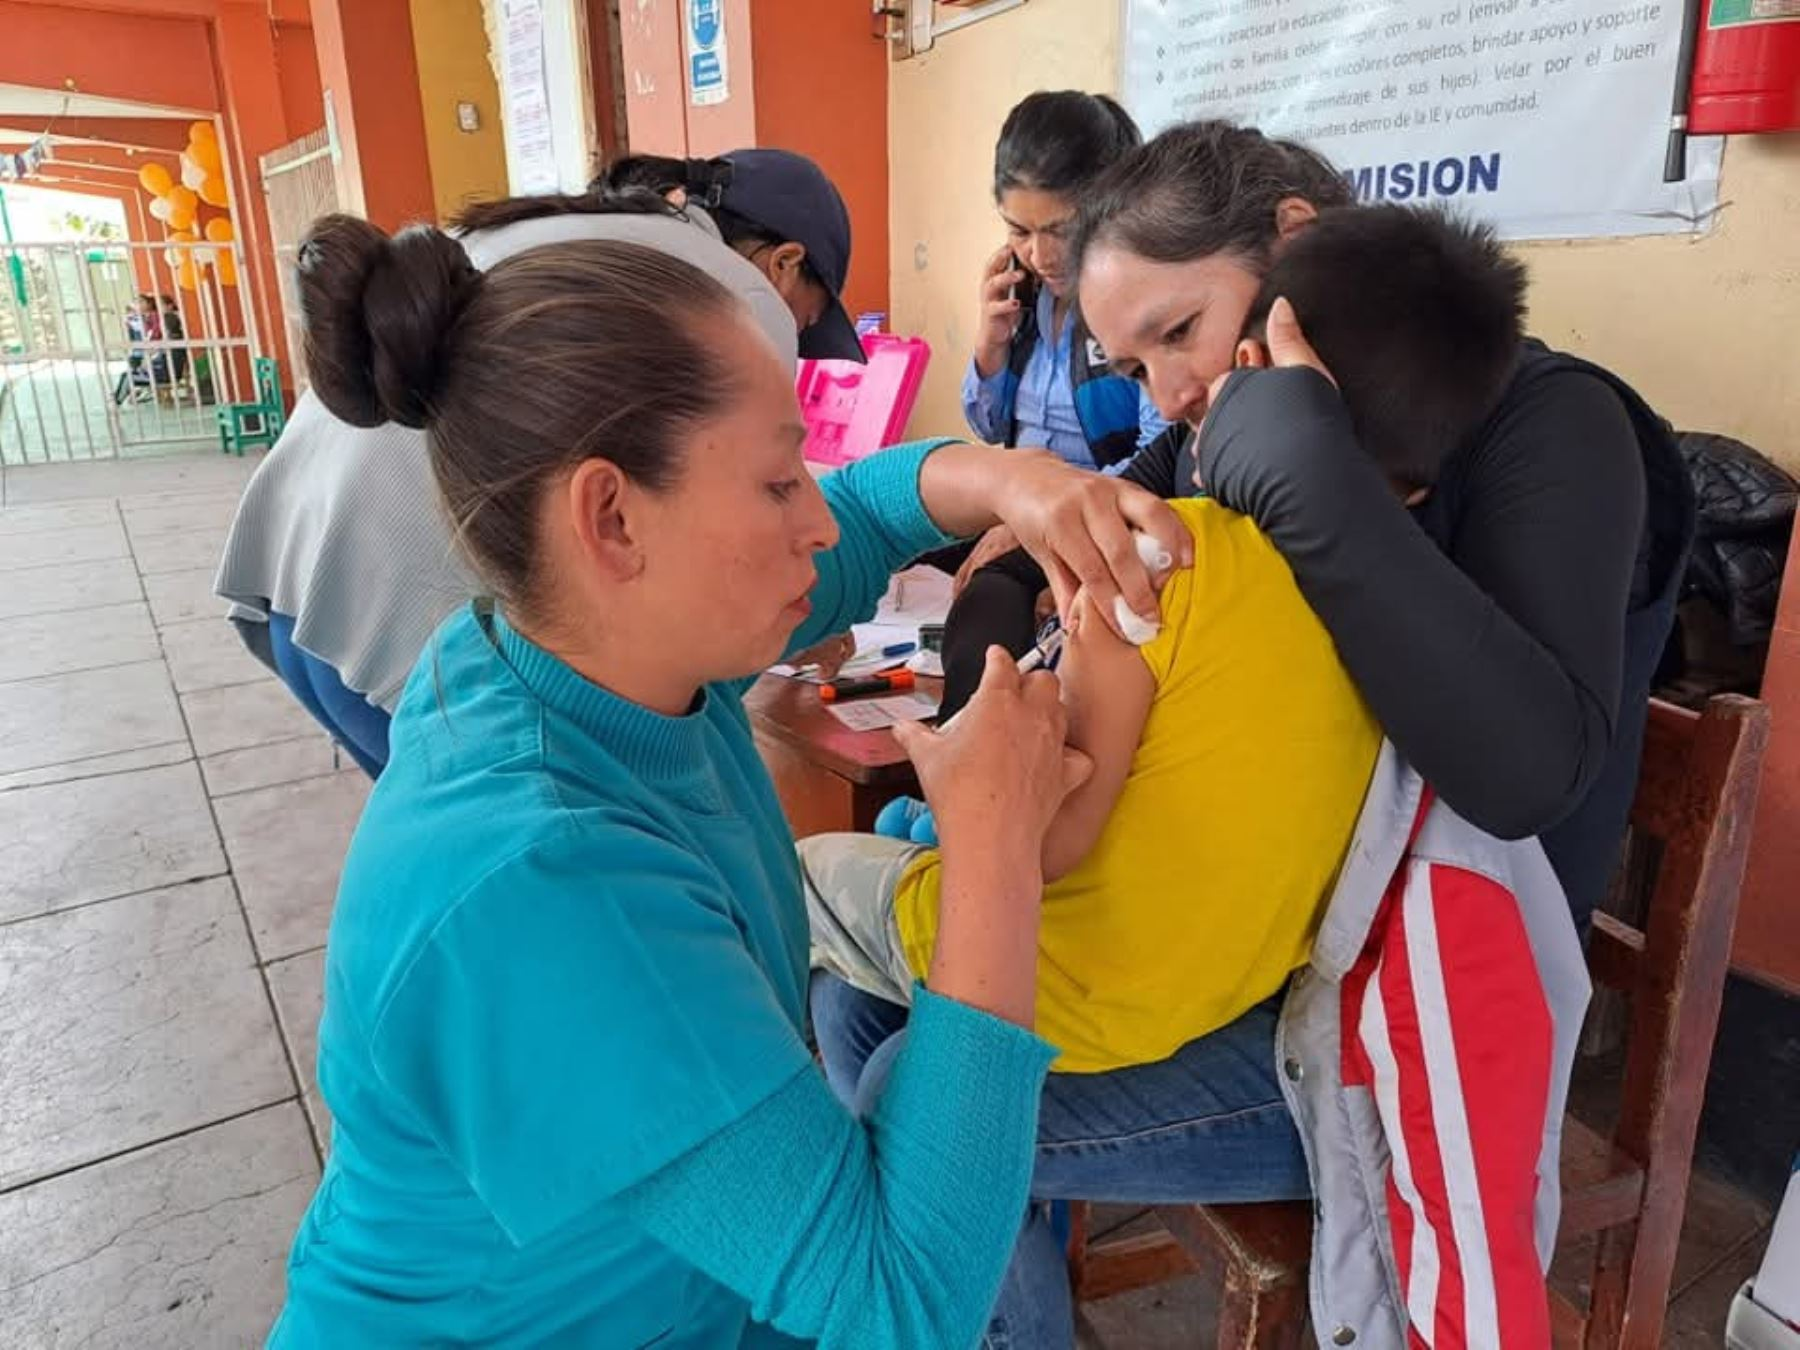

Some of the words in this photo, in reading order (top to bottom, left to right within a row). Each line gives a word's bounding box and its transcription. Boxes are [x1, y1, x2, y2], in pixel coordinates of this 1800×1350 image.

[1392, 43, 1468, 69] completos,
[1473, 29, 1525, 53] brindar
[1529, 21, 1578, 45] apoyo
[1582, 18, 1593, 34] y
[1596, 4, 1662, 35] soporte
[1416, 14, 1433, 31] su
[1441, 5, 1461, 27] rol
[1381, 82, 1398, 100] de
[1408, 81, 1429, 96] sus
[1494, 61, 1532, 82] Velar
[1544, 56, 1573, 75] por
[1586, 47, 1600, 67] el
[1613, 41, 1656, 63] buen
[1350, 115, 1392, 135] dentro
[1394, 110, 1412, 129] de
[1414, 108, 1427, 125] la
[1443, 106, 1453, 122] y
[1455, 90, 1540, 120] comunidad.
[1343, 153, 1501, 200] MISION
